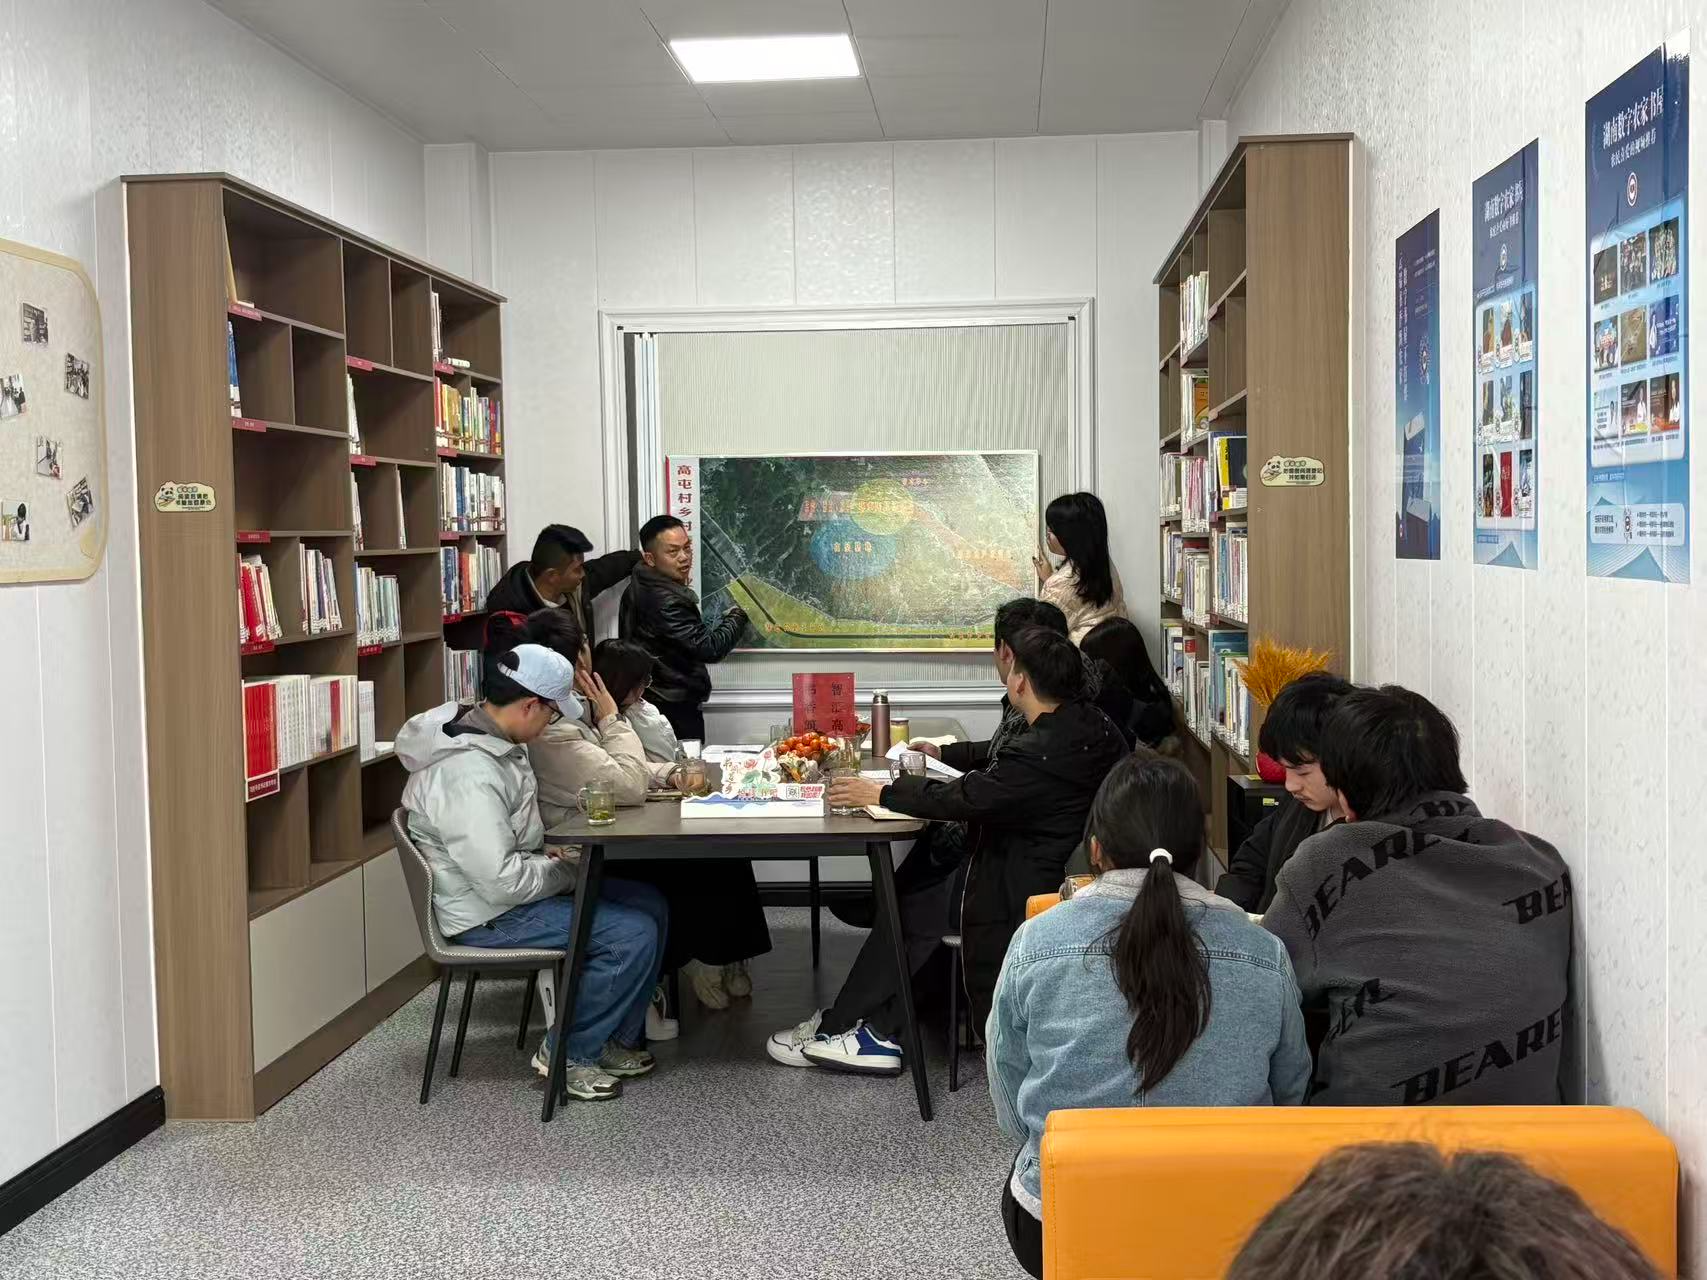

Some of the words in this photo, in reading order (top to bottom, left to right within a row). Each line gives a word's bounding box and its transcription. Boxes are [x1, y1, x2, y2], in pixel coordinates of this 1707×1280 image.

[1603, 84, 1664, 150] 湖南数字农家书屋
